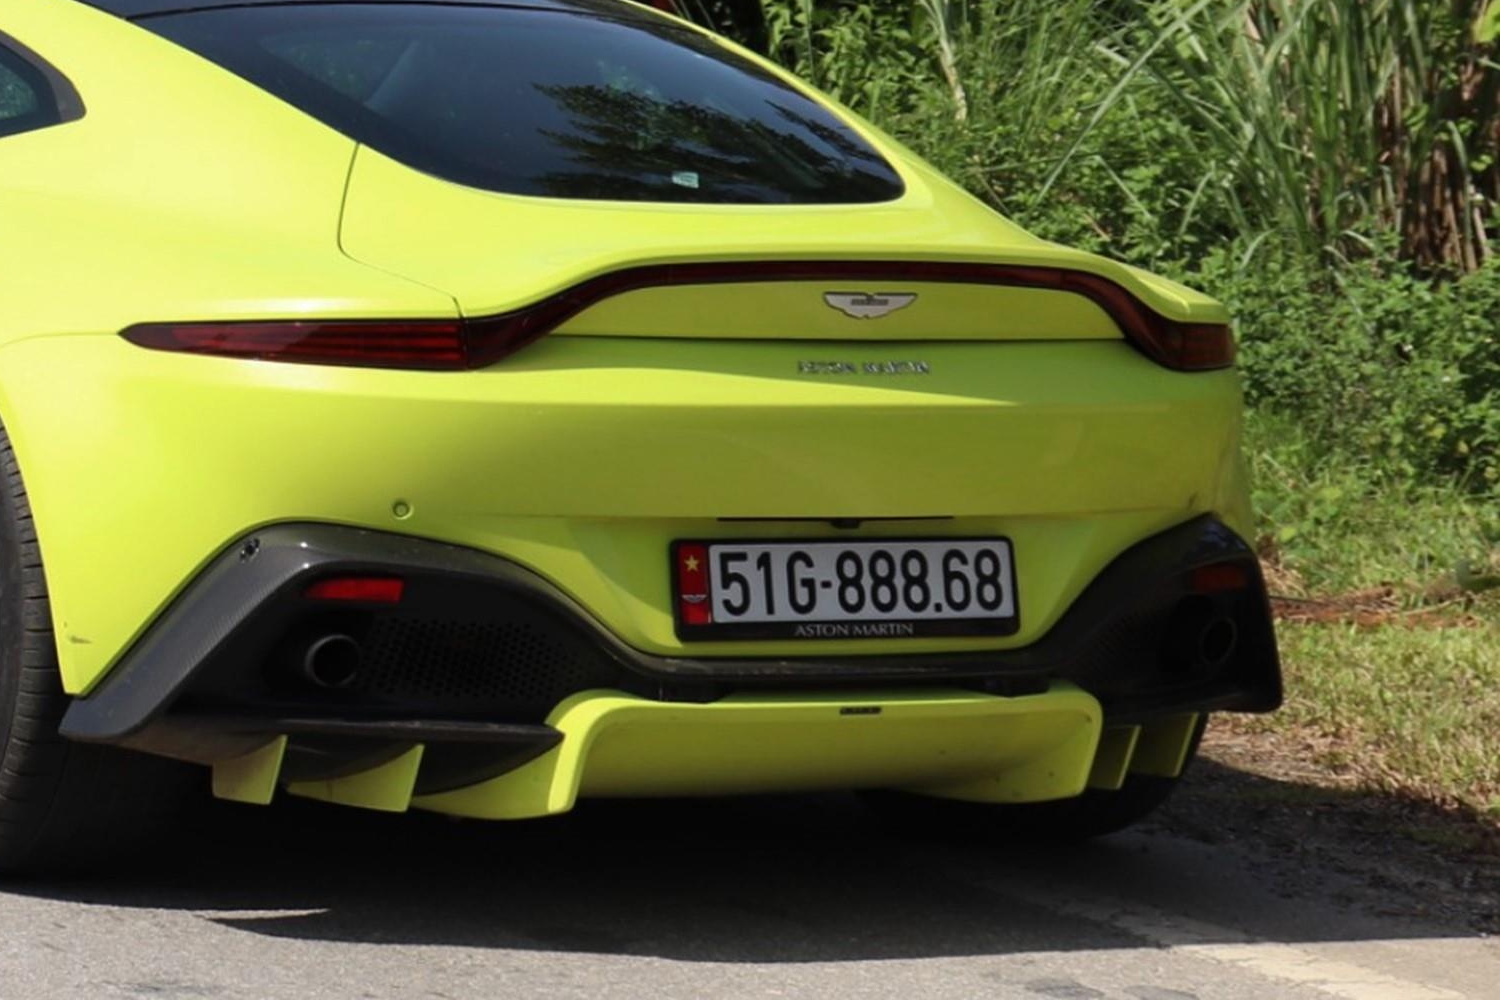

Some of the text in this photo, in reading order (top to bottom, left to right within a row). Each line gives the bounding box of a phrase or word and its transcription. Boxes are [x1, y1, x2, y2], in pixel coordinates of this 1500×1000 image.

[719, 548, 1005, 617] 51G-888.68
[795, 622, 914, 637] ASTON MARTIN
